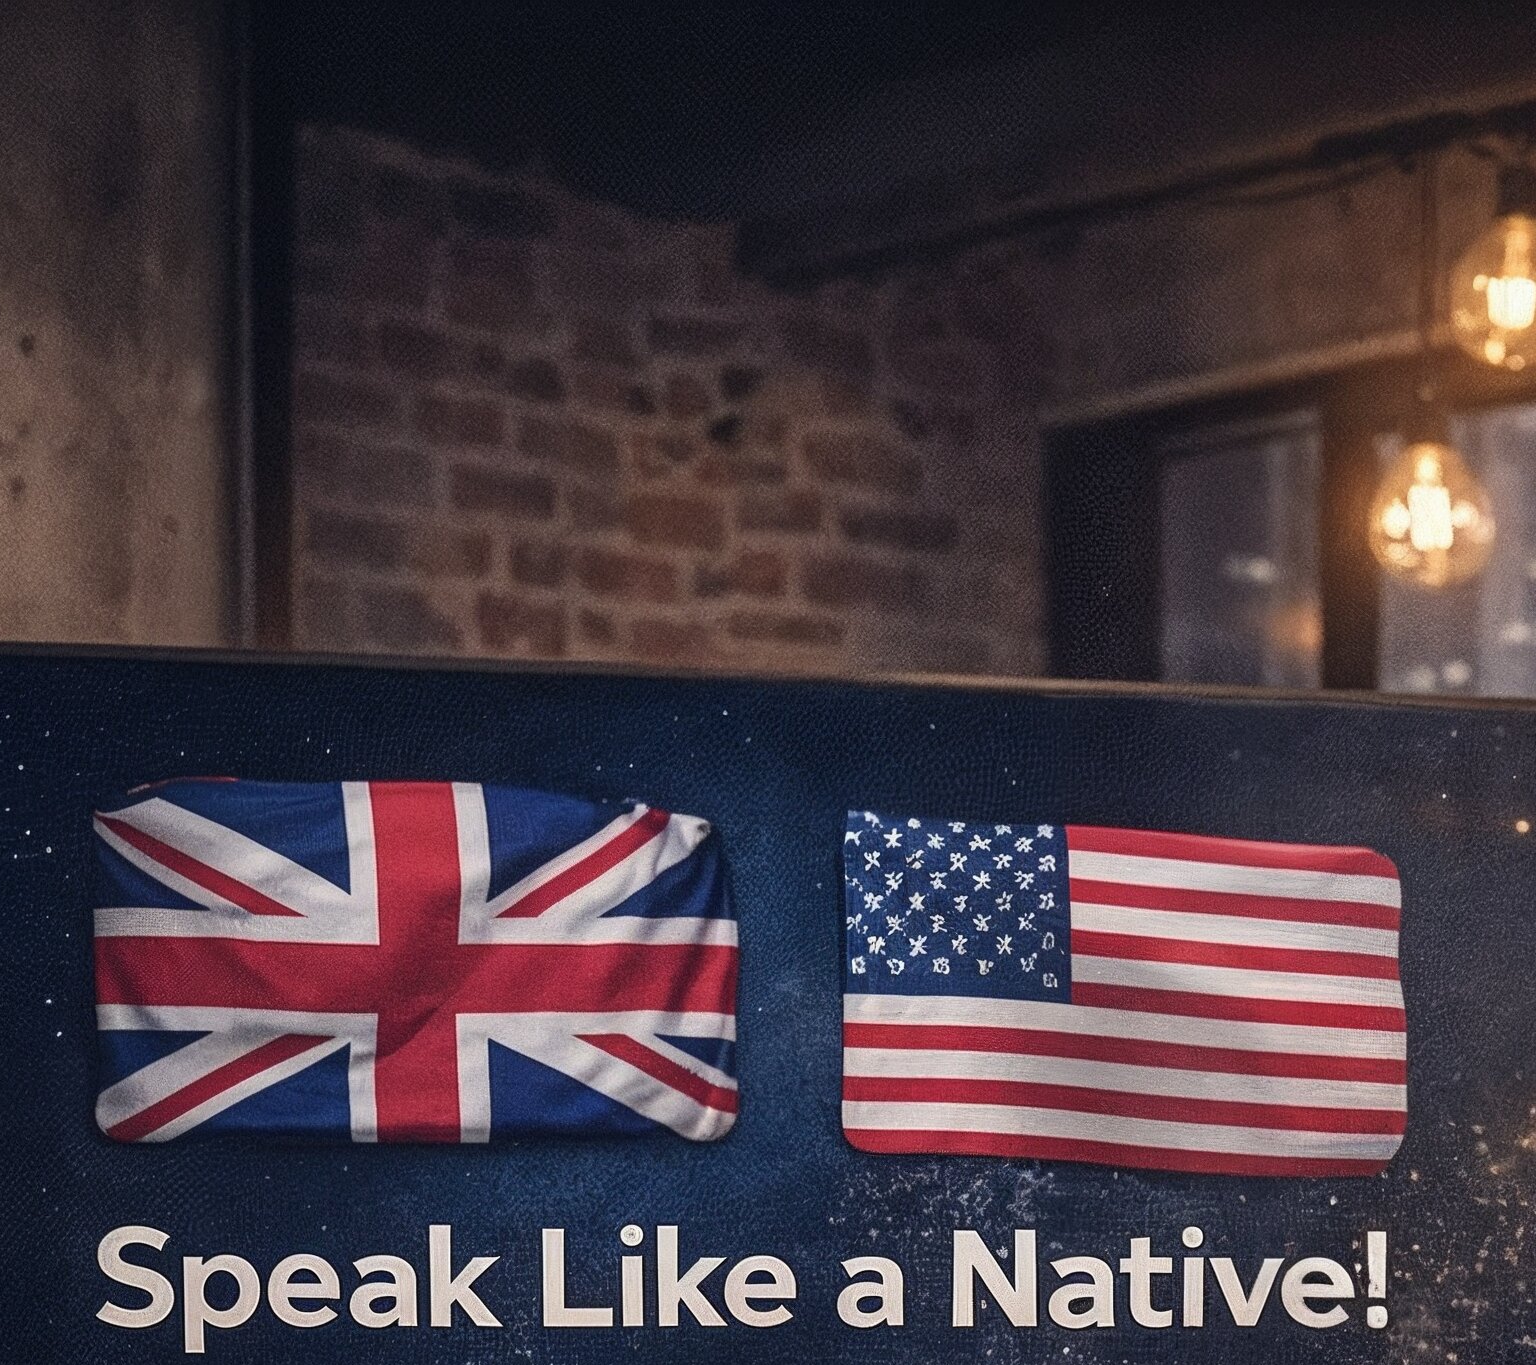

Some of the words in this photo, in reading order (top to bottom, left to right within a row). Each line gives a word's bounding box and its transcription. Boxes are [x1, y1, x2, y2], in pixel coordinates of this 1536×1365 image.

[93, 1222, 505, 1356] Speak
[539, 1222, 798, 1329] Like
[834, 1254, 905, 1329] a
[950, 1224, 1390, 1330] Native!
